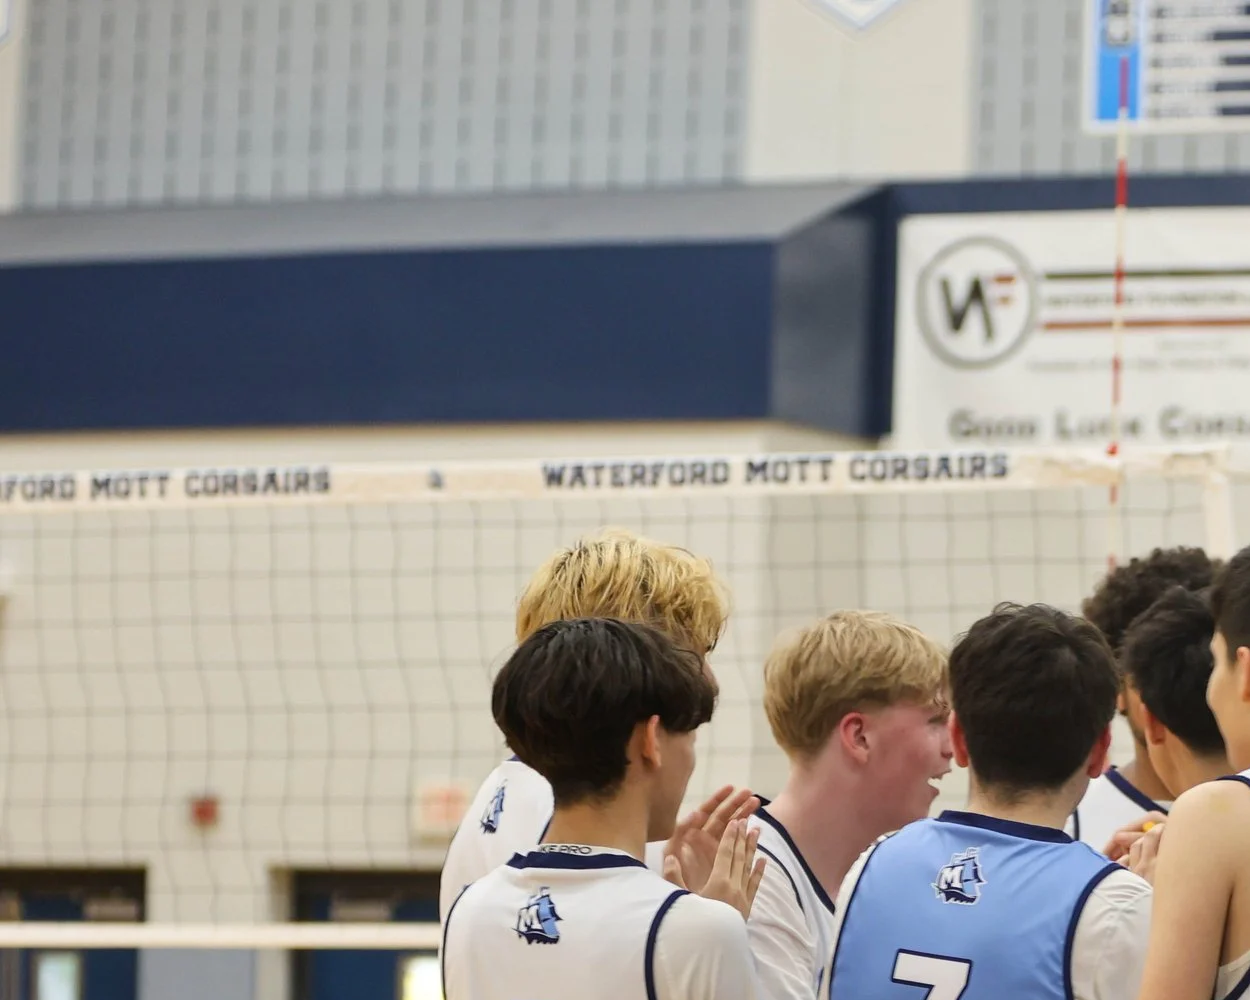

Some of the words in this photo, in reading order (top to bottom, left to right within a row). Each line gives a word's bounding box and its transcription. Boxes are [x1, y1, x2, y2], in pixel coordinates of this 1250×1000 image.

[1, 474, 77, 502] FORD
[89, 472, 170, 500] MOTT
[183, 466, 332, 497] CORSAIRS
[542, 462, 729, 489] WATERFORD
[745, 457, 835, 484] MOTT
[848, 453, 1010, 482] CORSAIRS
